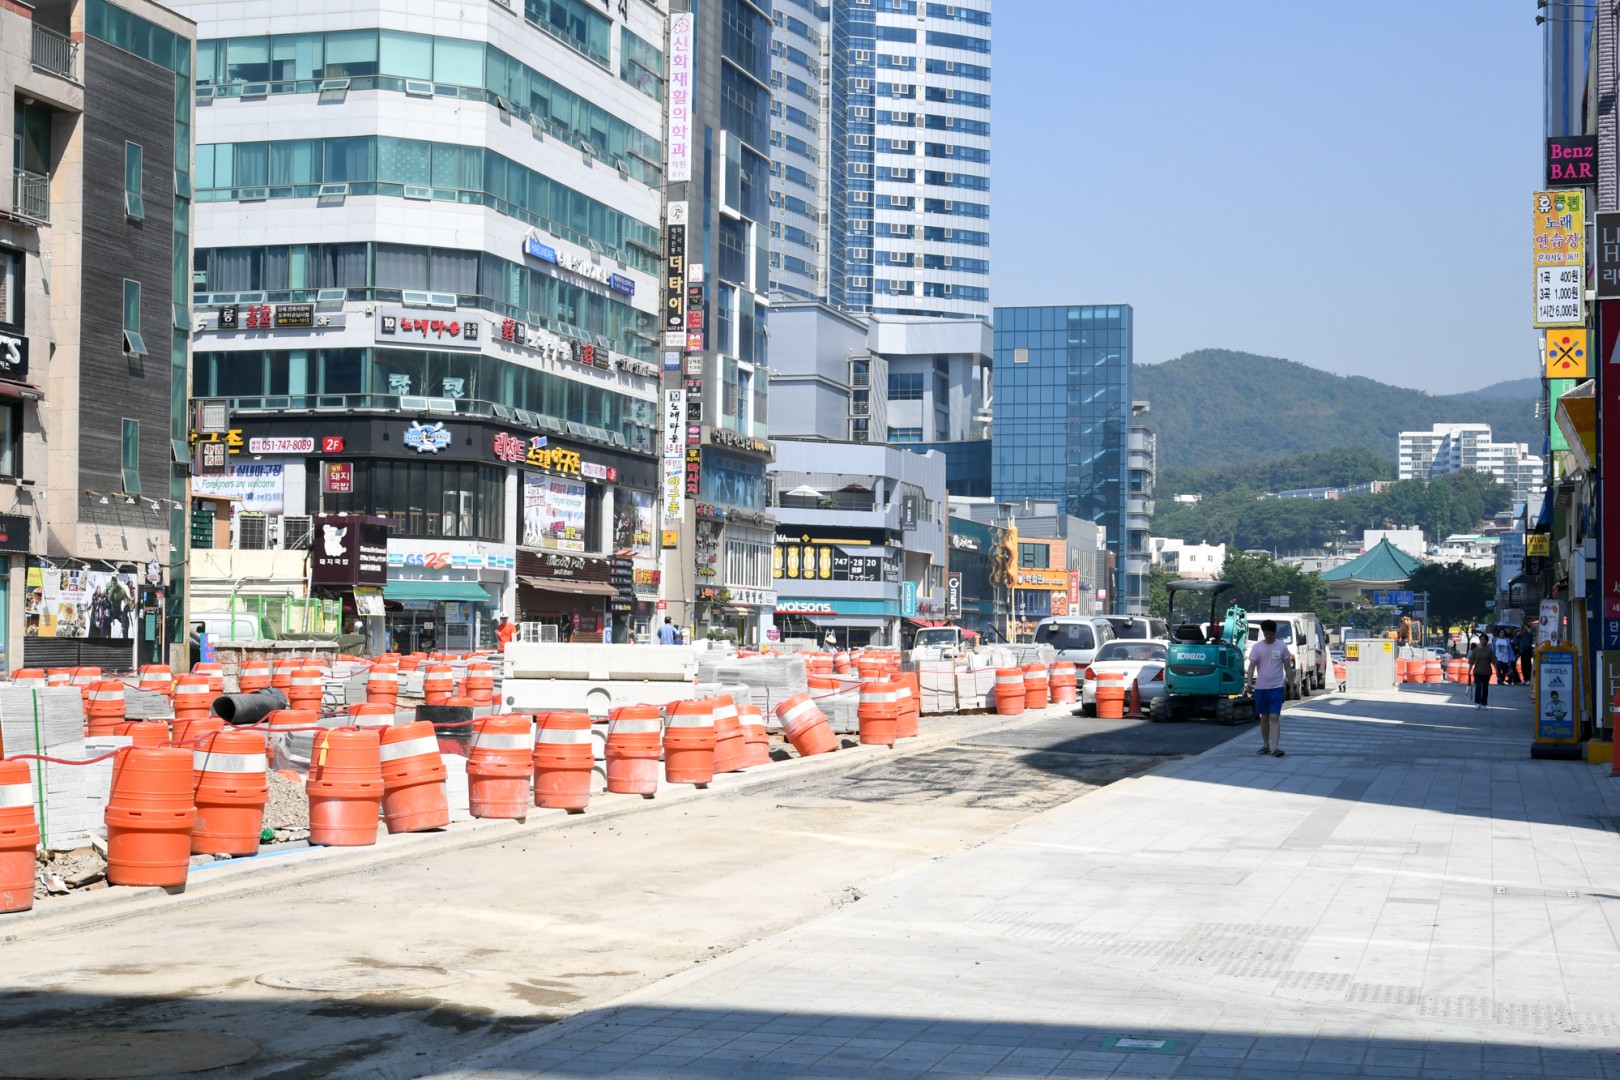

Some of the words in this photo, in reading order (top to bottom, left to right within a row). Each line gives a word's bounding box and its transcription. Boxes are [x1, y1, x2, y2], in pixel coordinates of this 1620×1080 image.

[671, 36, 689, 158] 신화재활의학과
[1551, 144, 1594, 159] Benz
[1551, 162, 1594, 179] BAR
[1545, 214, 1573, 230] 노래
[1536, 232, 1580, 249] 연습장
[1540, 271, 1551, 283] 1곡
[1560, 269, 1578, 283] 400원
[669, 255, 683, 315] 더타이
[1540, 288, 1551, 300] 3곡
[1554, 286, 1578, 300] 1,000원
[1540, 304, 1555, 317] 1시간
[1555, 303, 1578, 317] 6,000원
[384, 318, 395, 327] 10
[401, 318, 461, 338] 노래타운
[671, 392, 679, 400] 10
[669, 403, 680, 443] 노래타운
[262, 440, 312, 451] 051-747-8089
[326, 439, 340, 451] 2F
[494, 433, 526, 463] 레전드
[205, 456, 224, 465] 名品
[236, 464, 282, 477] 실내야구장
[330, 472, 350, 481] 돼지
[202, 480, 234, 490] Foreigners
[248, 480, 276, 488] welcome
[687, 463, 699, 494] 마사지
[331, 482, 350, 491] 국밥
[668, 476, 680, 514] 야구존
[319, 558, 349, 566] 돼지국밥
[406, 551, 450, 570] GS25
[834, 558, 848, 566] 747
[775, 602, 831, 612] watsons
[1177, 653, 1206, 661] KOBELCO
